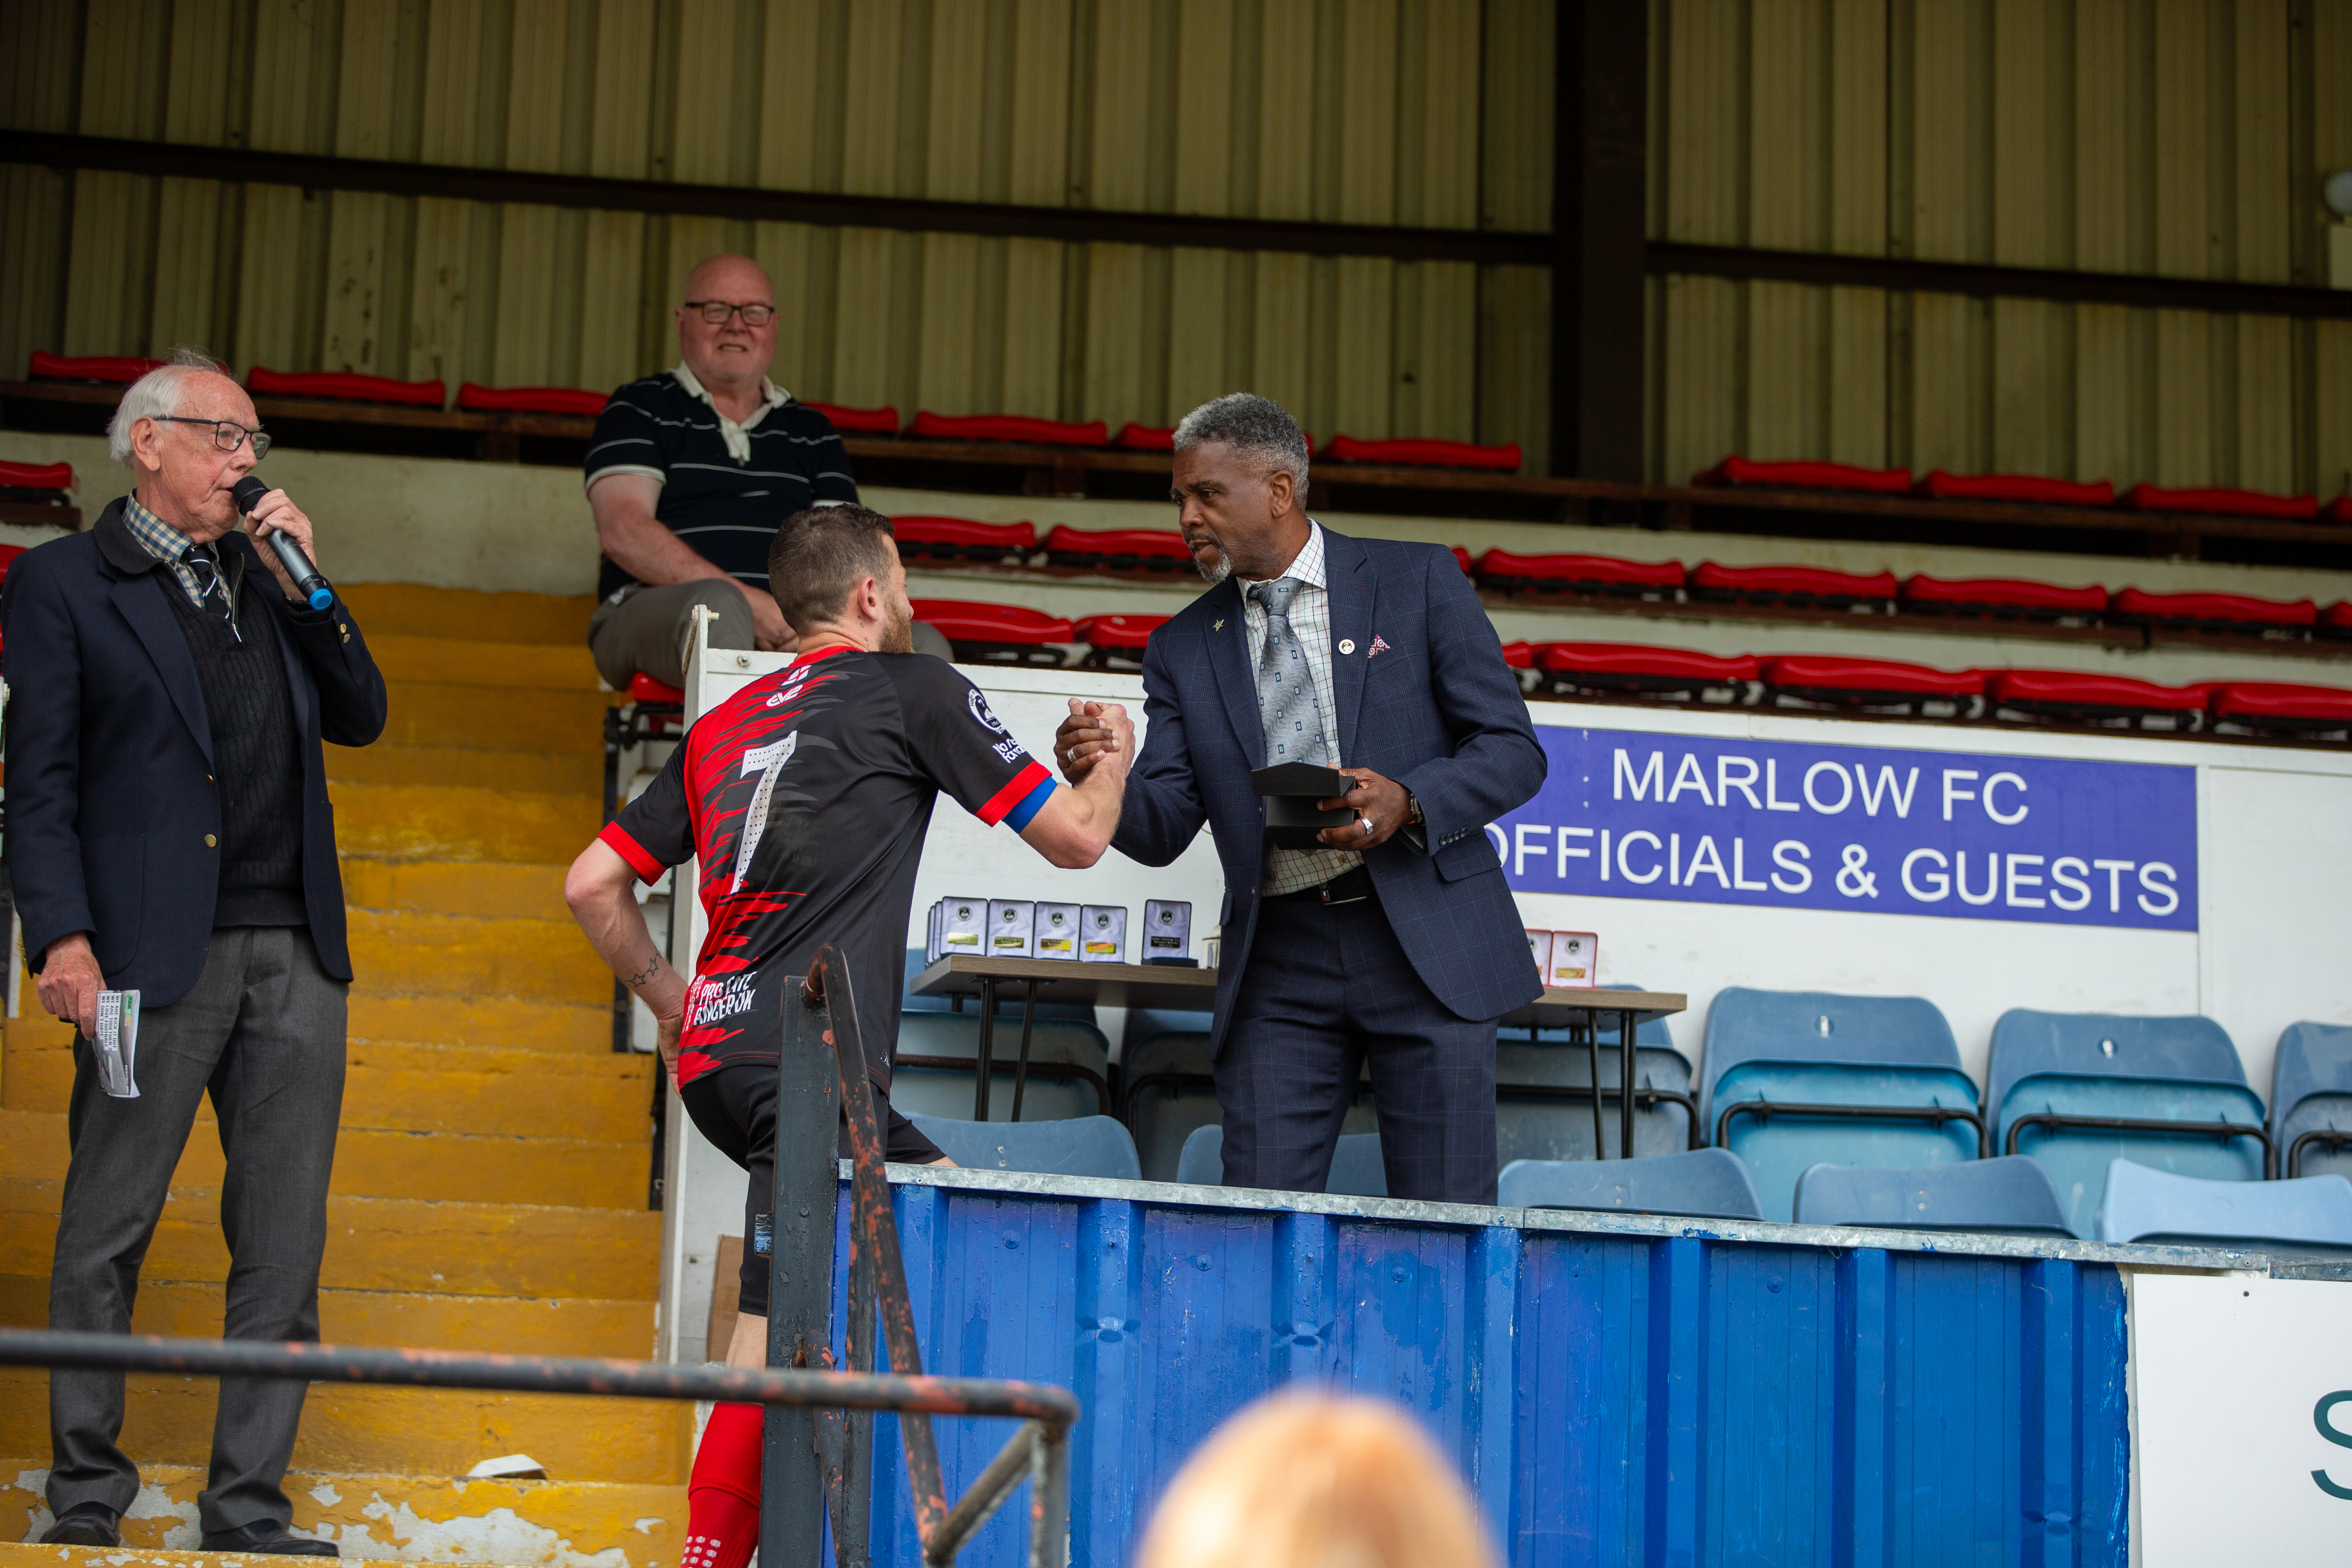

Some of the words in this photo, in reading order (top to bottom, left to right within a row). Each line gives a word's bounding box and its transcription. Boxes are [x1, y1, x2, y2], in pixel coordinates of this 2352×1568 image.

[992, 743, 1008, 755] No
[1613, 748, 1920, 818] MARLOW
[1943, 768, 2029, 825] FC
[730, 730, 798, 894] 7
[1835, 843, 1879, 899] &
[1901, 848, 2179, 916] GUESTS
[102, 995, 106, 1004] WE
[106, 995, 111, 1004] WE
[111, 995, 115, 1004] WE
[115, 995, 120, 1004] WE
